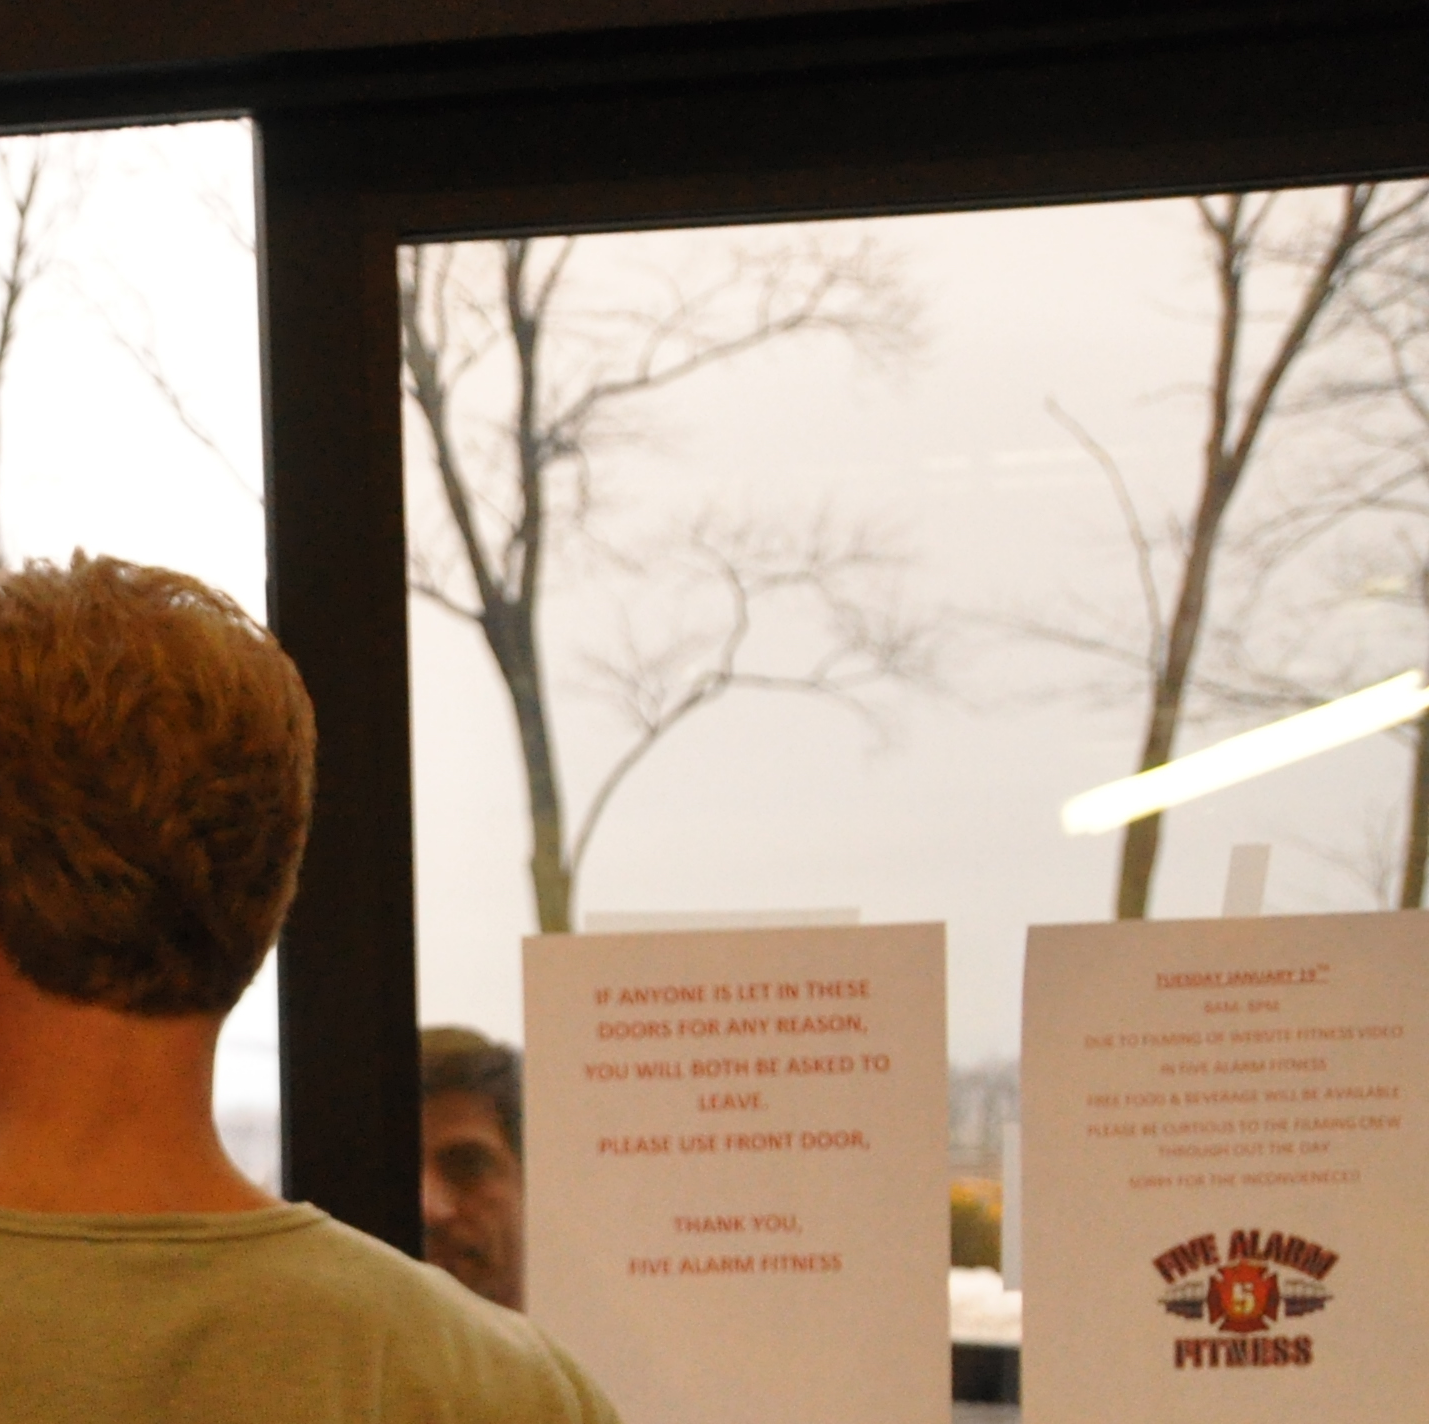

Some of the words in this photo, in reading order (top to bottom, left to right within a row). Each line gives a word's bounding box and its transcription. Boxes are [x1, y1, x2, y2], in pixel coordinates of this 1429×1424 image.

[1156, 972, 1222, 990] TUESDAY
[1227, 970, 1294, 987] JANUARY
[595, 987, 608, 1004] IF
[618, 985, 705, 1004] ANYONE
[714, 984, 731, 1001] IS
[740, 982, 771, 1000] LET
[778, 982, 799, 999] IN
[805, 979, 870, 998] THESE
[598, 1020, 671, 1040] DOORS
[678, 1018, 719, 1036] FOR
[727, 1017, 769, 1034] ANY
[1120, 1034, 1138, 1047] TO
[1297, 1027, 1354, 1041] FITNESS
[1358, 1025, 1404, 1039] VIDEO
[585, 1062, 628, 1080] YOU
[637, 1061, 682, 1079] WILL
[693, 1059, 748, 1077] BOTH
[756, 1057, 778, 1075] BE
[787, 1055, 854, 1074] ASKED
[862, 1053, 890, 1072] TO
[1179, 1061, 1208, 1074] FIVE
[1214, 1060, 1266, 1073] ALARM
[1269, 1058, 1327, 1072] FITNESS
[698, 1092, 769, 1111] LEAVE.
[1125, 1094, 1165, 1106] FOOD
[1264, 1090, 1296, 1103] WILL
[1301, 1088, 1317, 1101] BE
[1323, 1085, 1399, 1100] AVAILABLE
[1088, 1123, 1137, 1137] PLEASE
[1142, 1123, 1157, 1136] BE
[1238, 1119, 1259, 1132] TO
[1263, 1118, 1287, 1131] THE
[1294, 1116, 1357, 1130] FILMING
[1359, 1115, 1402, 1129] CREW
[598, 1135, 670, 1154] PLEASE
[680, 1134, 716, 1151] USE
[725, 1132, 793, 1150] FRONT
[1158, 1145, 1230, 1157] THROUGH
[1233, 1143, 1264, 1156] OUT
[1268, 1142, 1294, 1154] THE
[1299, 1141, 1330, 1154] DAY
[1177, 1173, 1206, 1186] FOR
[1210, 1172, 1236, 1185] THE
[674, 1215, 745, 1232] THANK
[628, 1257, 670, 1275] FIVE
[679, 1255, 755, 1274] ALARM
[761, 1253, 842, 1273] FITNESS
[1152, 1231, 1220, 1285] FIVE
[1227, 1228, 1340, 1281] ALARM
[1232, 1281, 1256, 1315] 5
[1173, 1334, 1315, 1370] FITNESS
